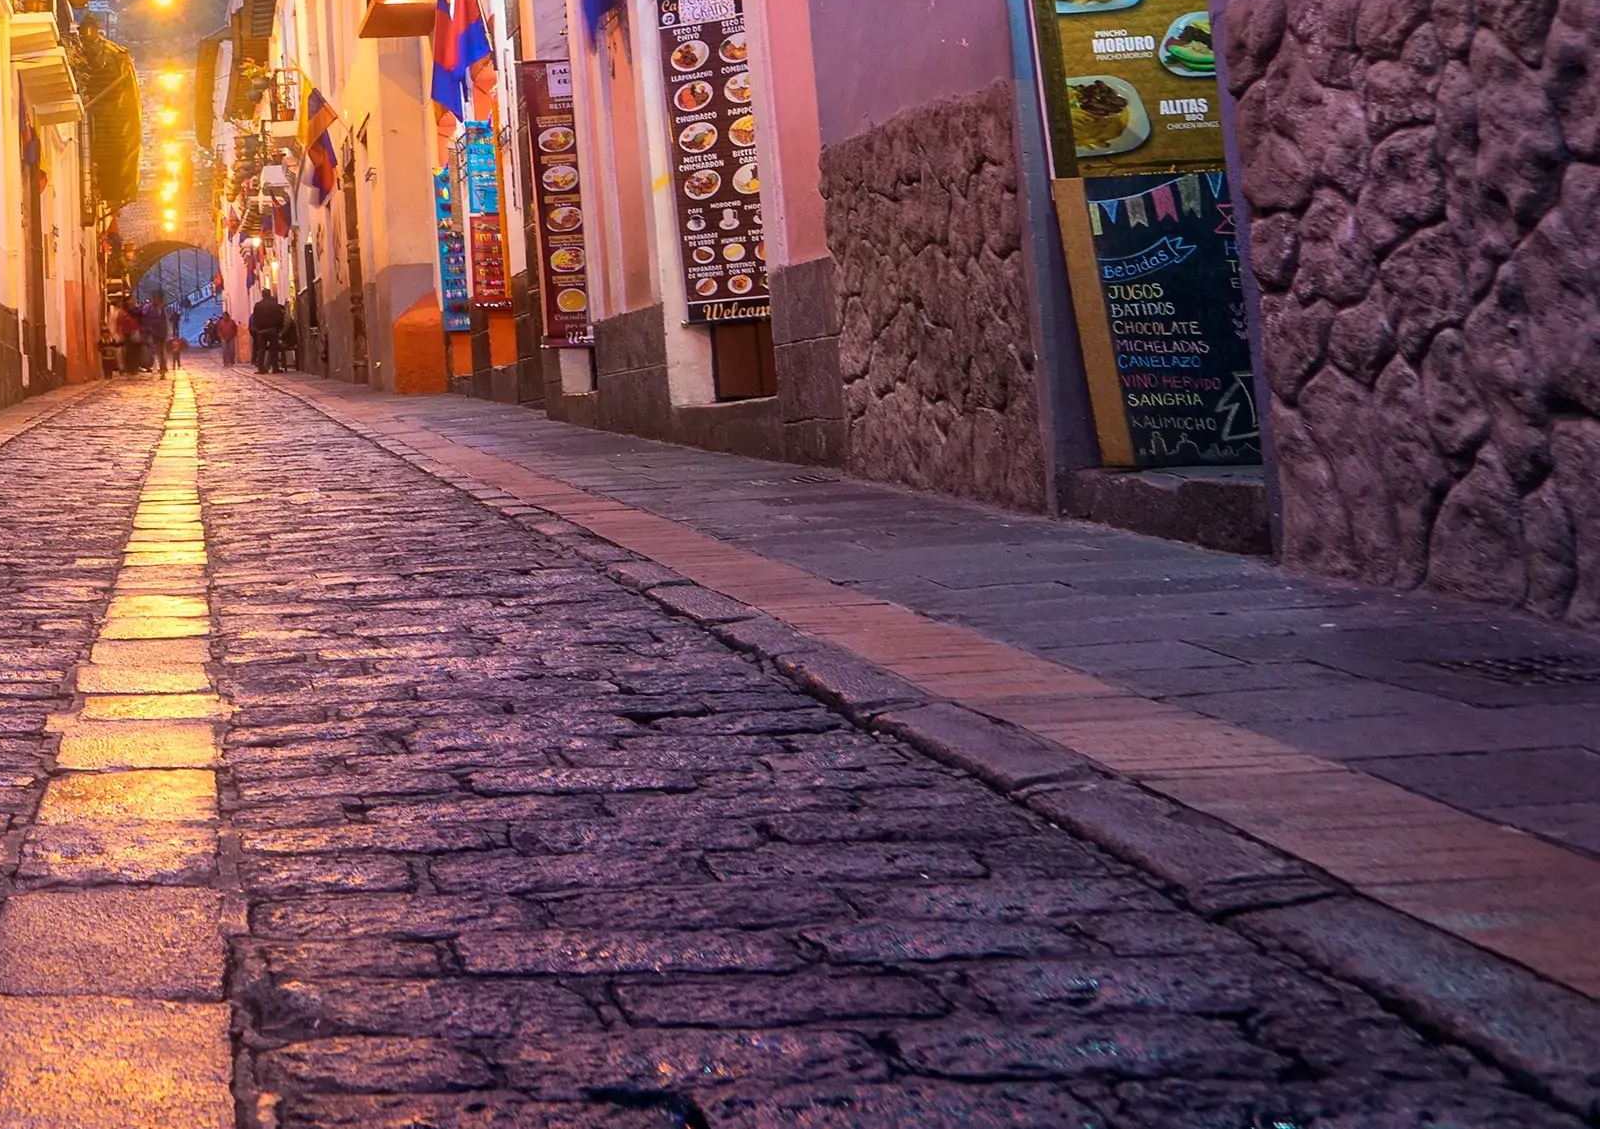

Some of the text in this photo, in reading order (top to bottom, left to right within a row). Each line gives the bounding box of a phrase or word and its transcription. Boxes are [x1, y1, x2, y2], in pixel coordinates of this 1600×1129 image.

[721, 18, 736, 27] SECO
[672, 26, 692, 36] SECO
[677, 32, 700, 42] CHIVO
[1095, 29, 1127, 38] PINCHO
[1092, 36, 1155, 54] MORURO
[1096, 52, 1153, 61] PINCHO MORURO
[1160, 98, 1209, 115] ALITAS
[675, 111, 717, 124] CHURRASCO
[1167, 121, 1220, 130] CHICKEN WINGS
[683, 153, 718, 164] MOTE CON
[679, 159, 724, 172] CHICHARRON
[710, 200, 742, 209] MOROCHO
[1102, 249, 1169, 279] Bebidas
[1108, 282, 1164, 300] JUGOS
[1112, 320, 1202, 335] CHOCOLATE
[1116, 339, 1210, 354] MICHELADAS
[1117, 354, 1201, 368] CANELAZO
[1121, 373, 1221, 390] VINO HERVIDO
